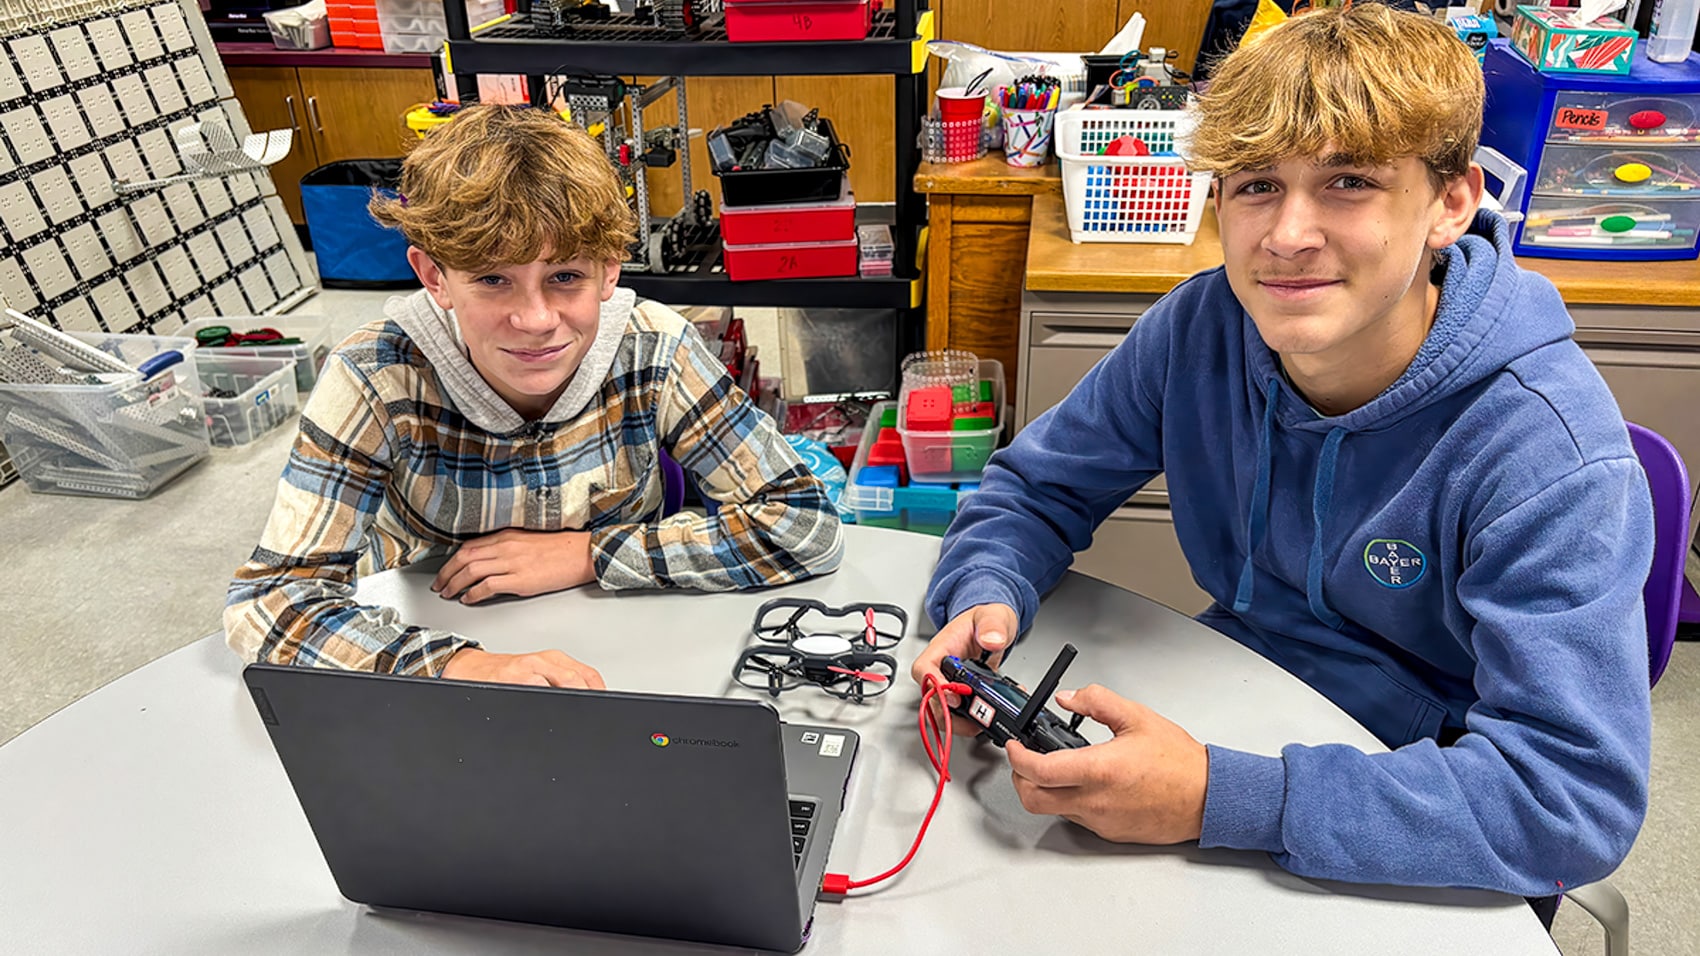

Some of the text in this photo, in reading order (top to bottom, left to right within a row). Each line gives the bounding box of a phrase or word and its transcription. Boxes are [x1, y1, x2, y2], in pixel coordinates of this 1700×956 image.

[792, 14, 813, 30] 4B
[1562, 109, 1601, 126] Pencils
[777, 256, 798, 272] 2A
[1369, 554, 1421, 567] BAYER
[1386, 543, 1402, 584] BAYER
[976, 705, 987, 719] H
